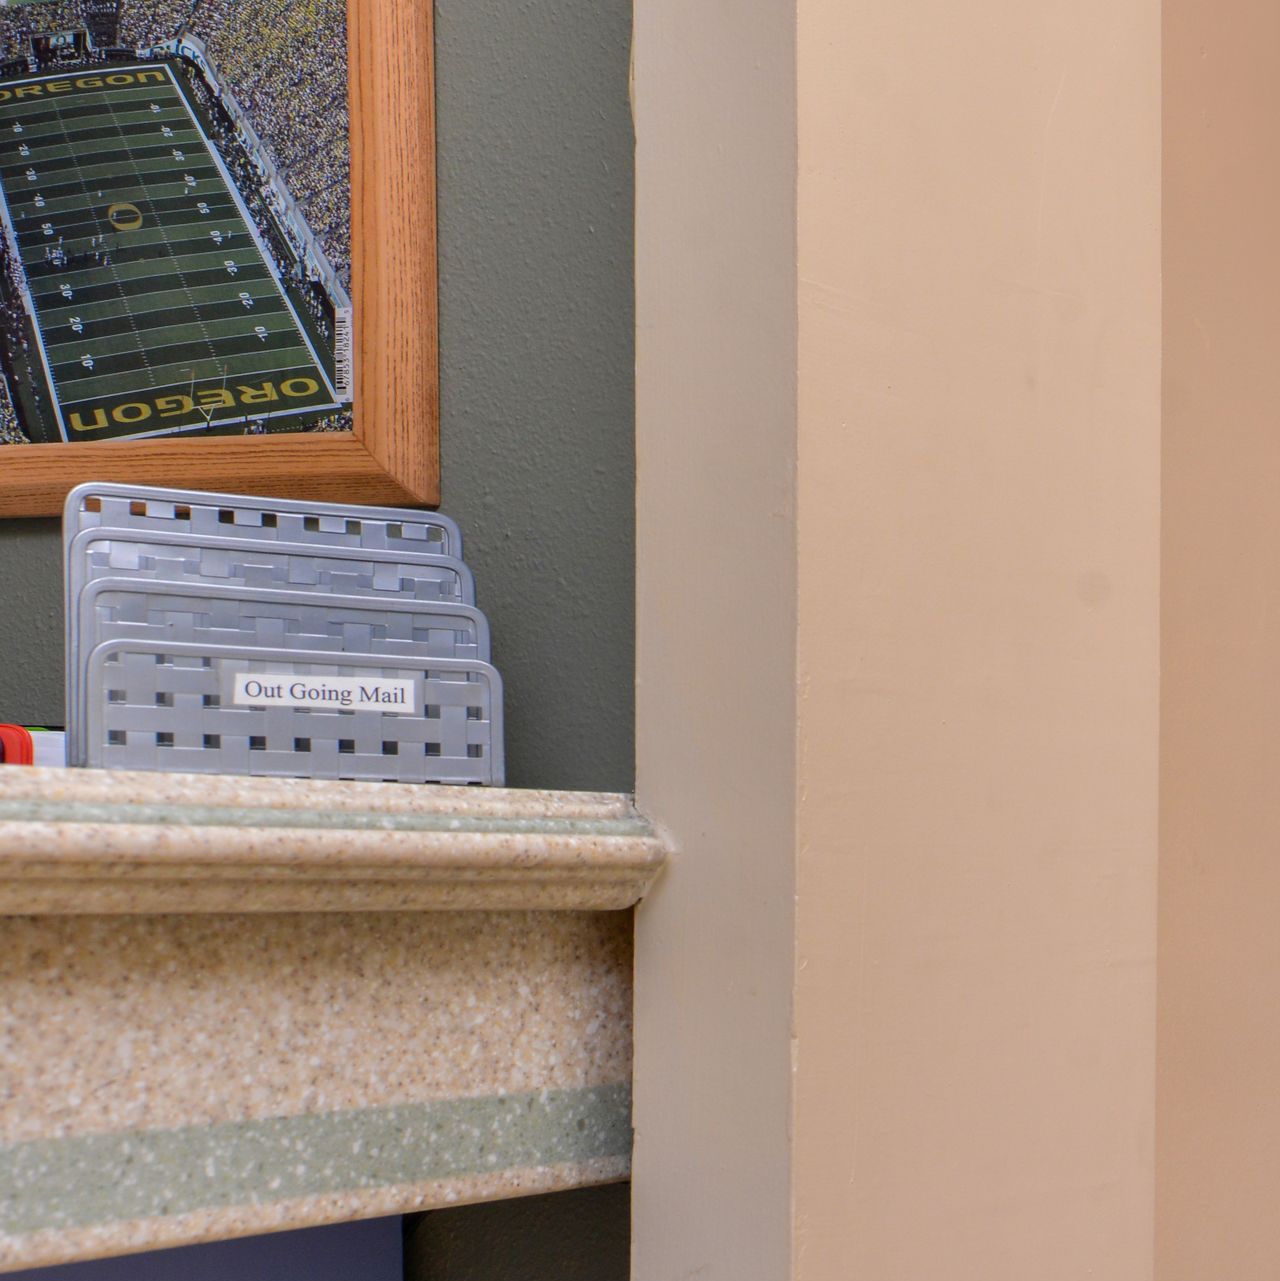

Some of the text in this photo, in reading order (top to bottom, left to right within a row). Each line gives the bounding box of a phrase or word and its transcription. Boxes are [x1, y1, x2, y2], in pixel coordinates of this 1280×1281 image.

[68, 376, 320, 432] OREGON
[244, 681, 408, 706] Out Going Mail
